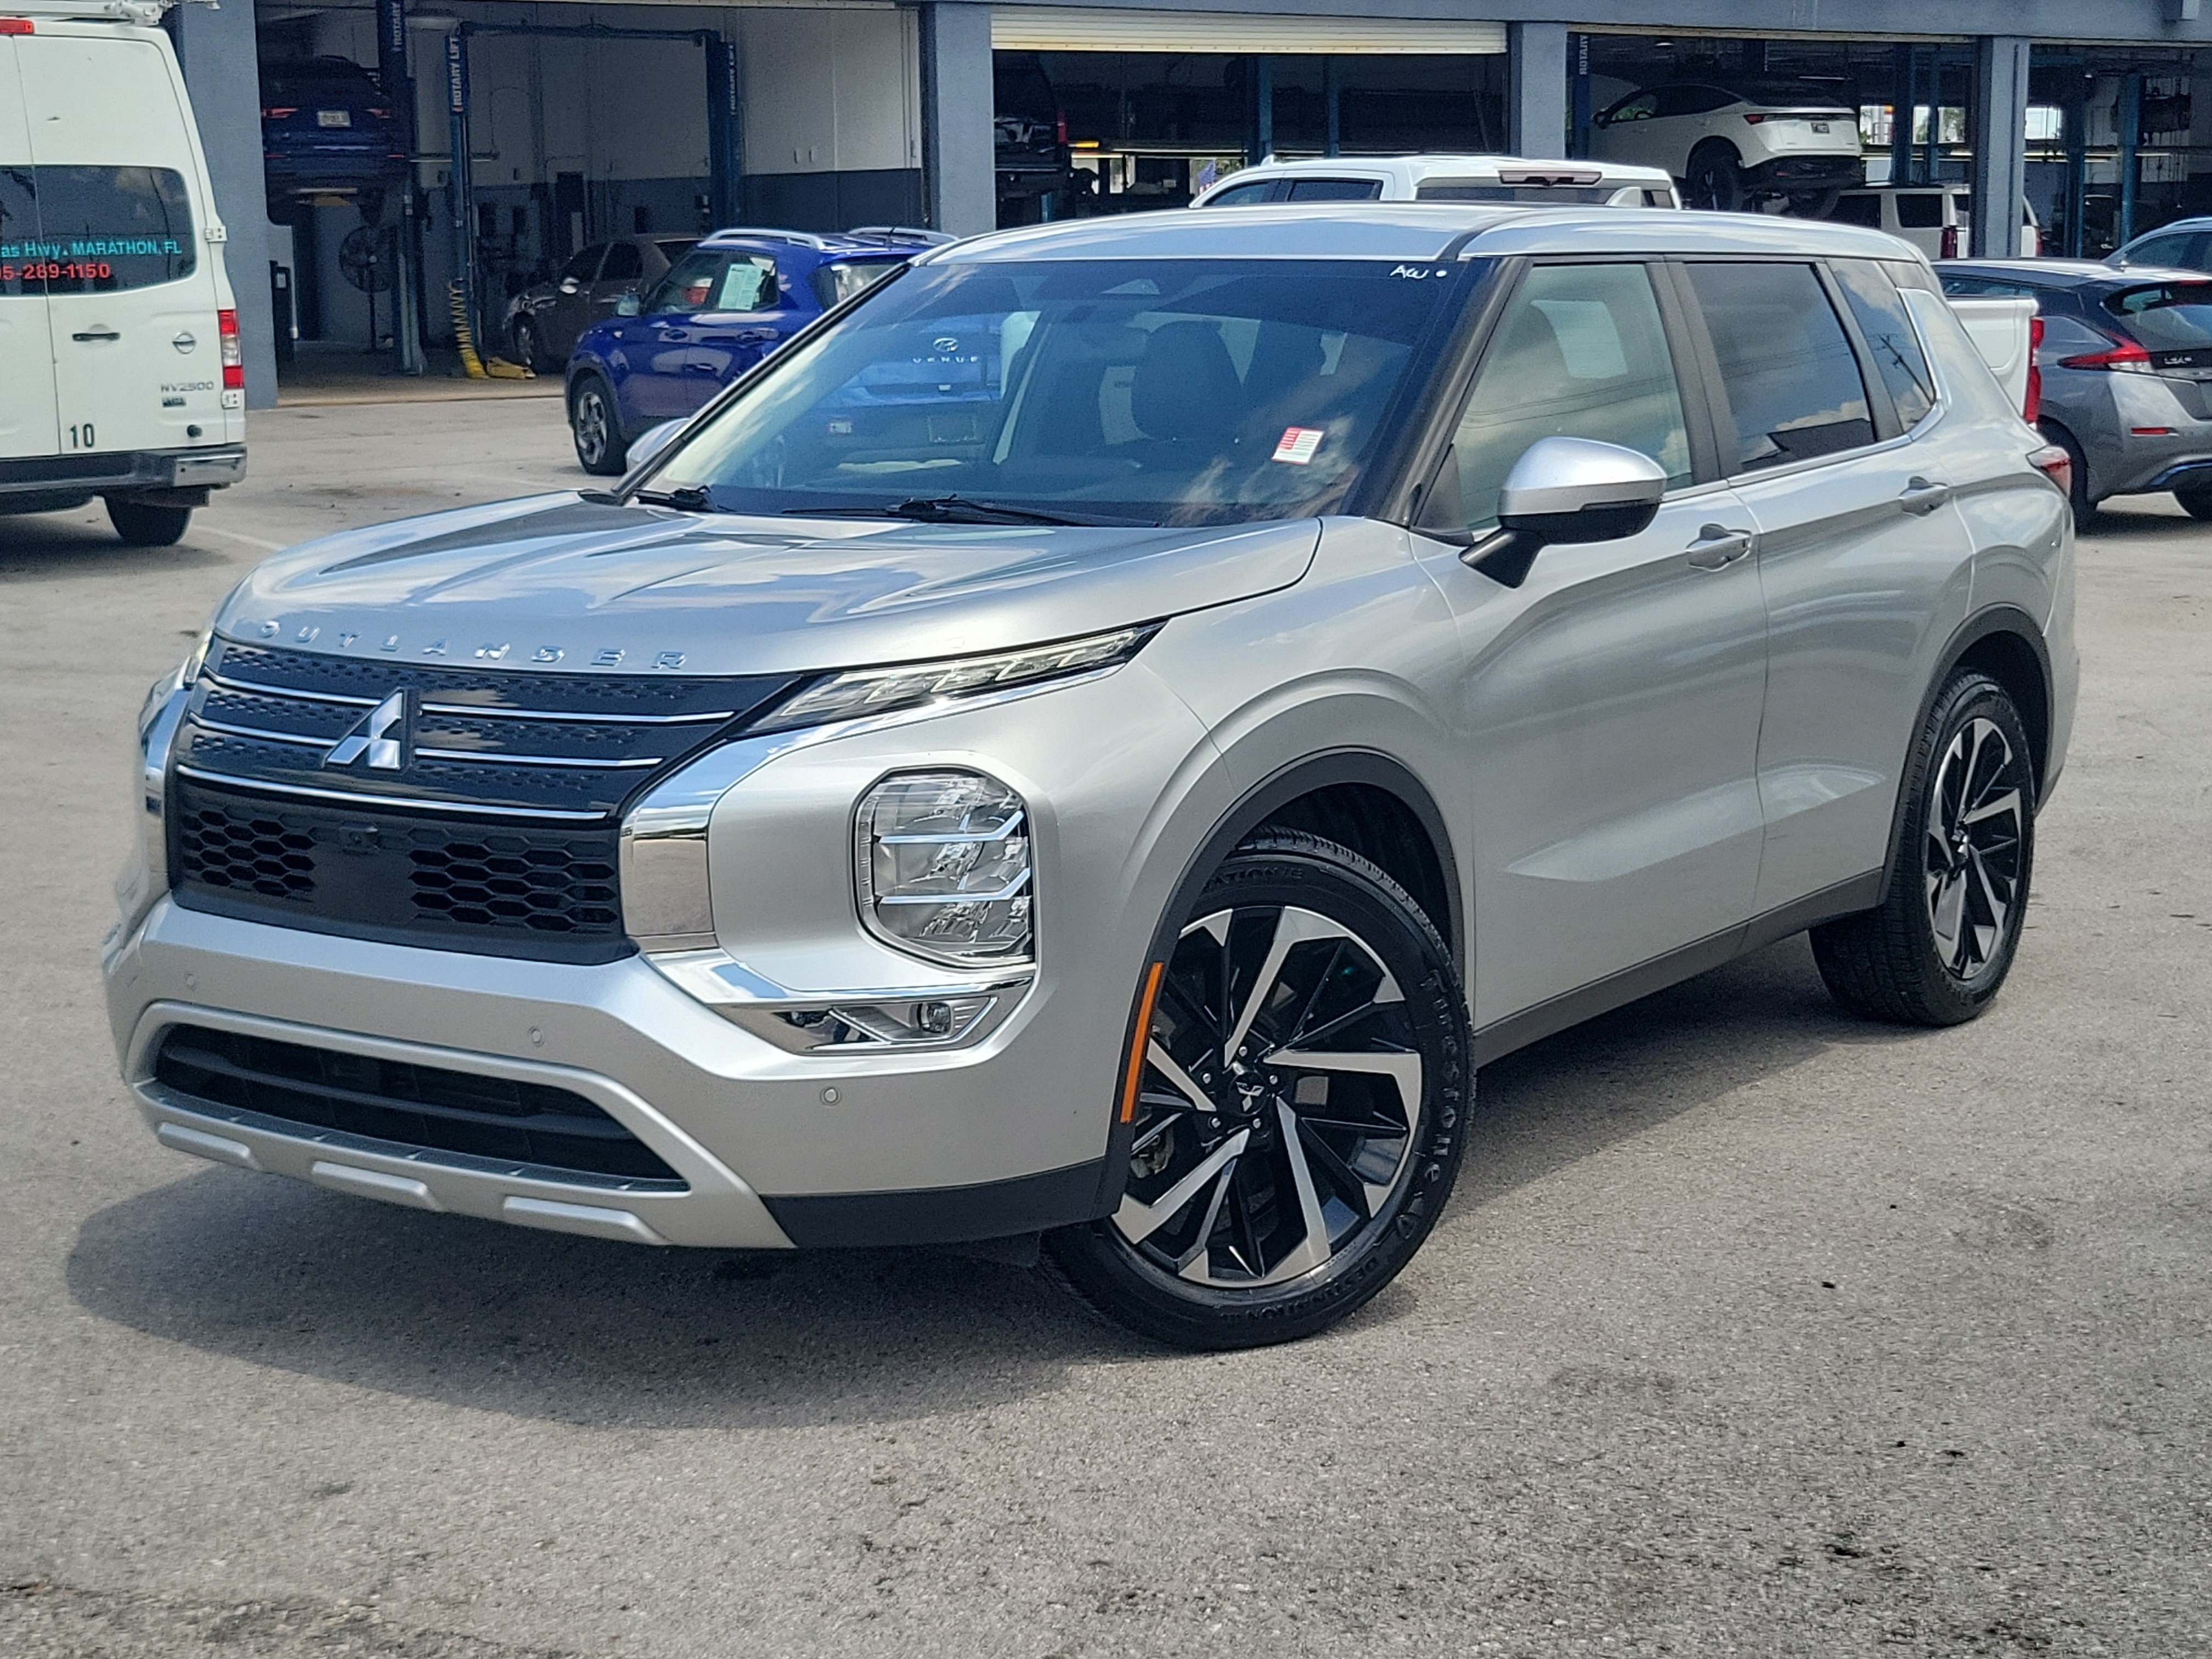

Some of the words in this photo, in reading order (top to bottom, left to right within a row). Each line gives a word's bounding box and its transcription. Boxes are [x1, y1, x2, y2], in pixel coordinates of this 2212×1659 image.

[450, 63, 462, 106] ROTARY
[164, 240, 182, 254] FL
[0, 263, 110, 280] 5-289-1150
[70, 423, 95, 449] 10
[257, 620, 686, 669] OUTLANDER
